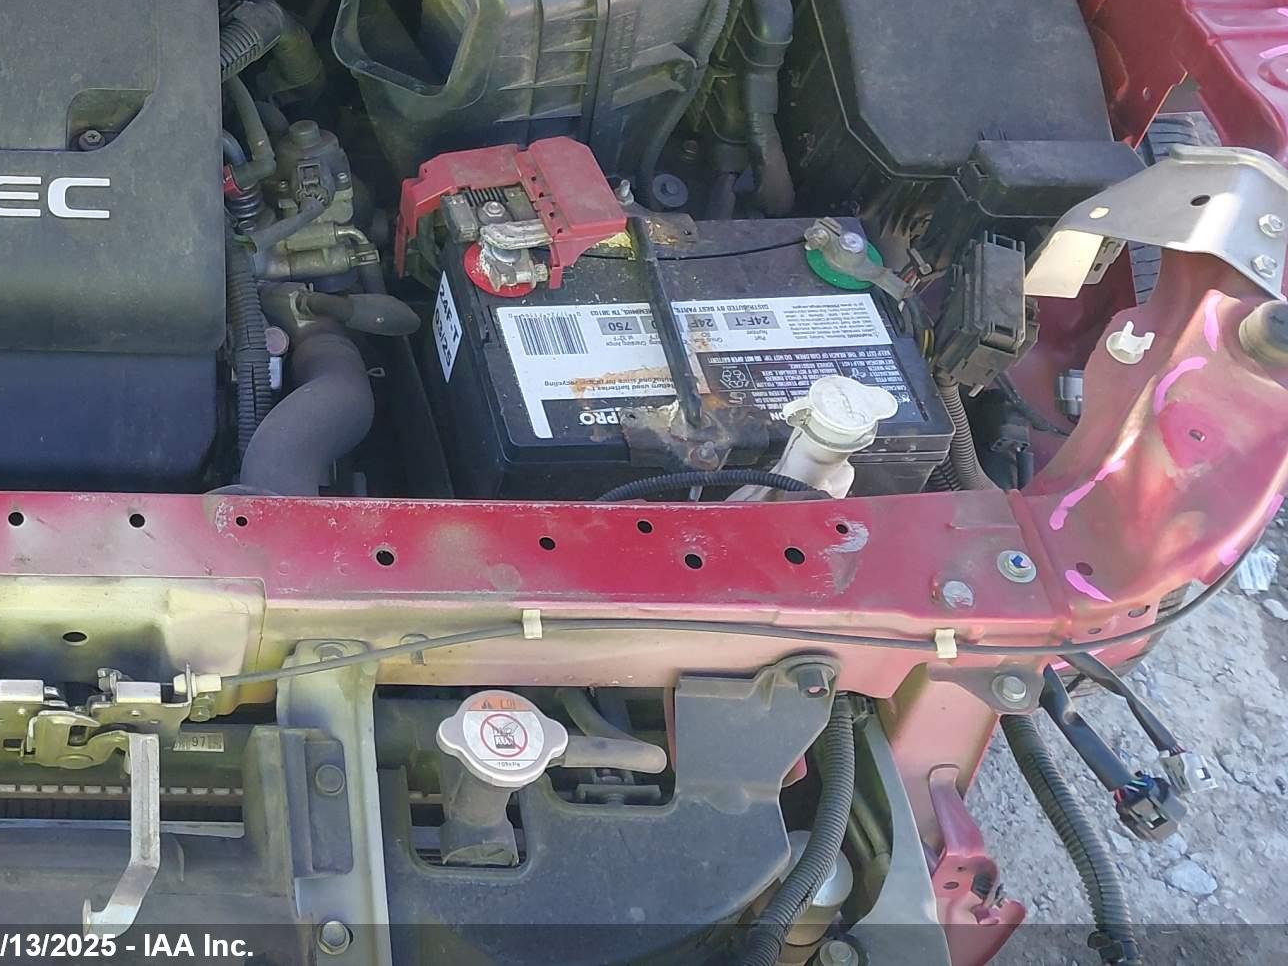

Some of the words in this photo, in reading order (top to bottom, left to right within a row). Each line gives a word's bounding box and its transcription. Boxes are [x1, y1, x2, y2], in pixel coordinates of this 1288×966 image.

[691, 318, 714, 328] 24F
[735, 316, 770, 326] 24F-T
[608, 322, 632, 331] 750
[580, 411, 618, 425] PRO
